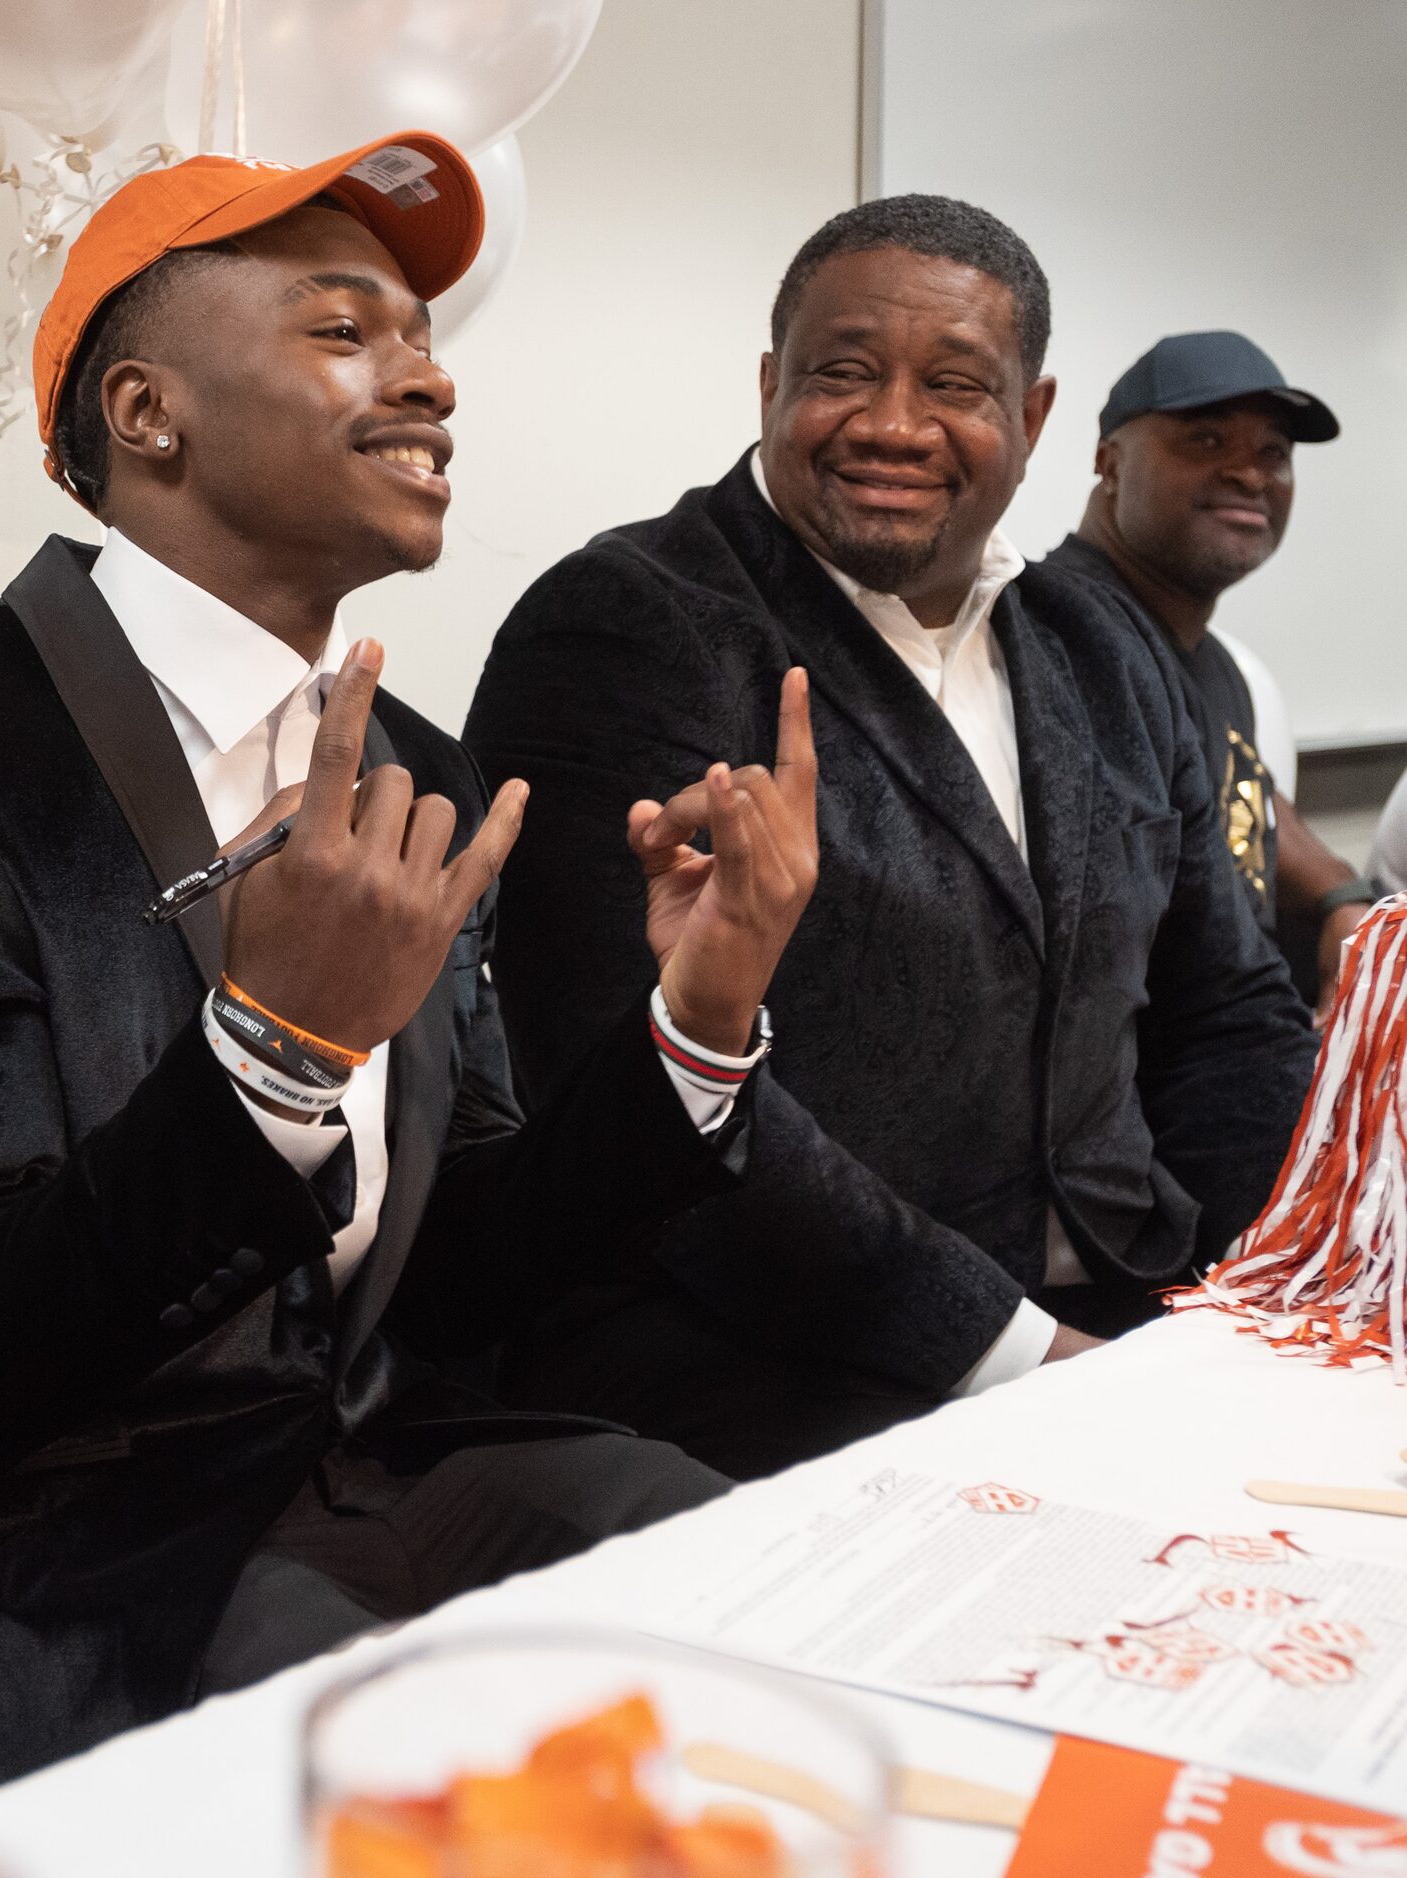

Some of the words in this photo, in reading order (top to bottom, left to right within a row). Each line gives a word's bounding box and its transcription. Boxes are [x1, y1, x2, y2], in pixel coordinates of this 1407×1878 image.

[222, 1004, 266, 1038] LONGHORN
[302, 1037, 354, 1065] LONGHORN
[301, 1059, 334, 1088] FOOTBALL
[261, 1075, 299, 1101] BRAKES.
[299, 1094, 314, 1105] NO
